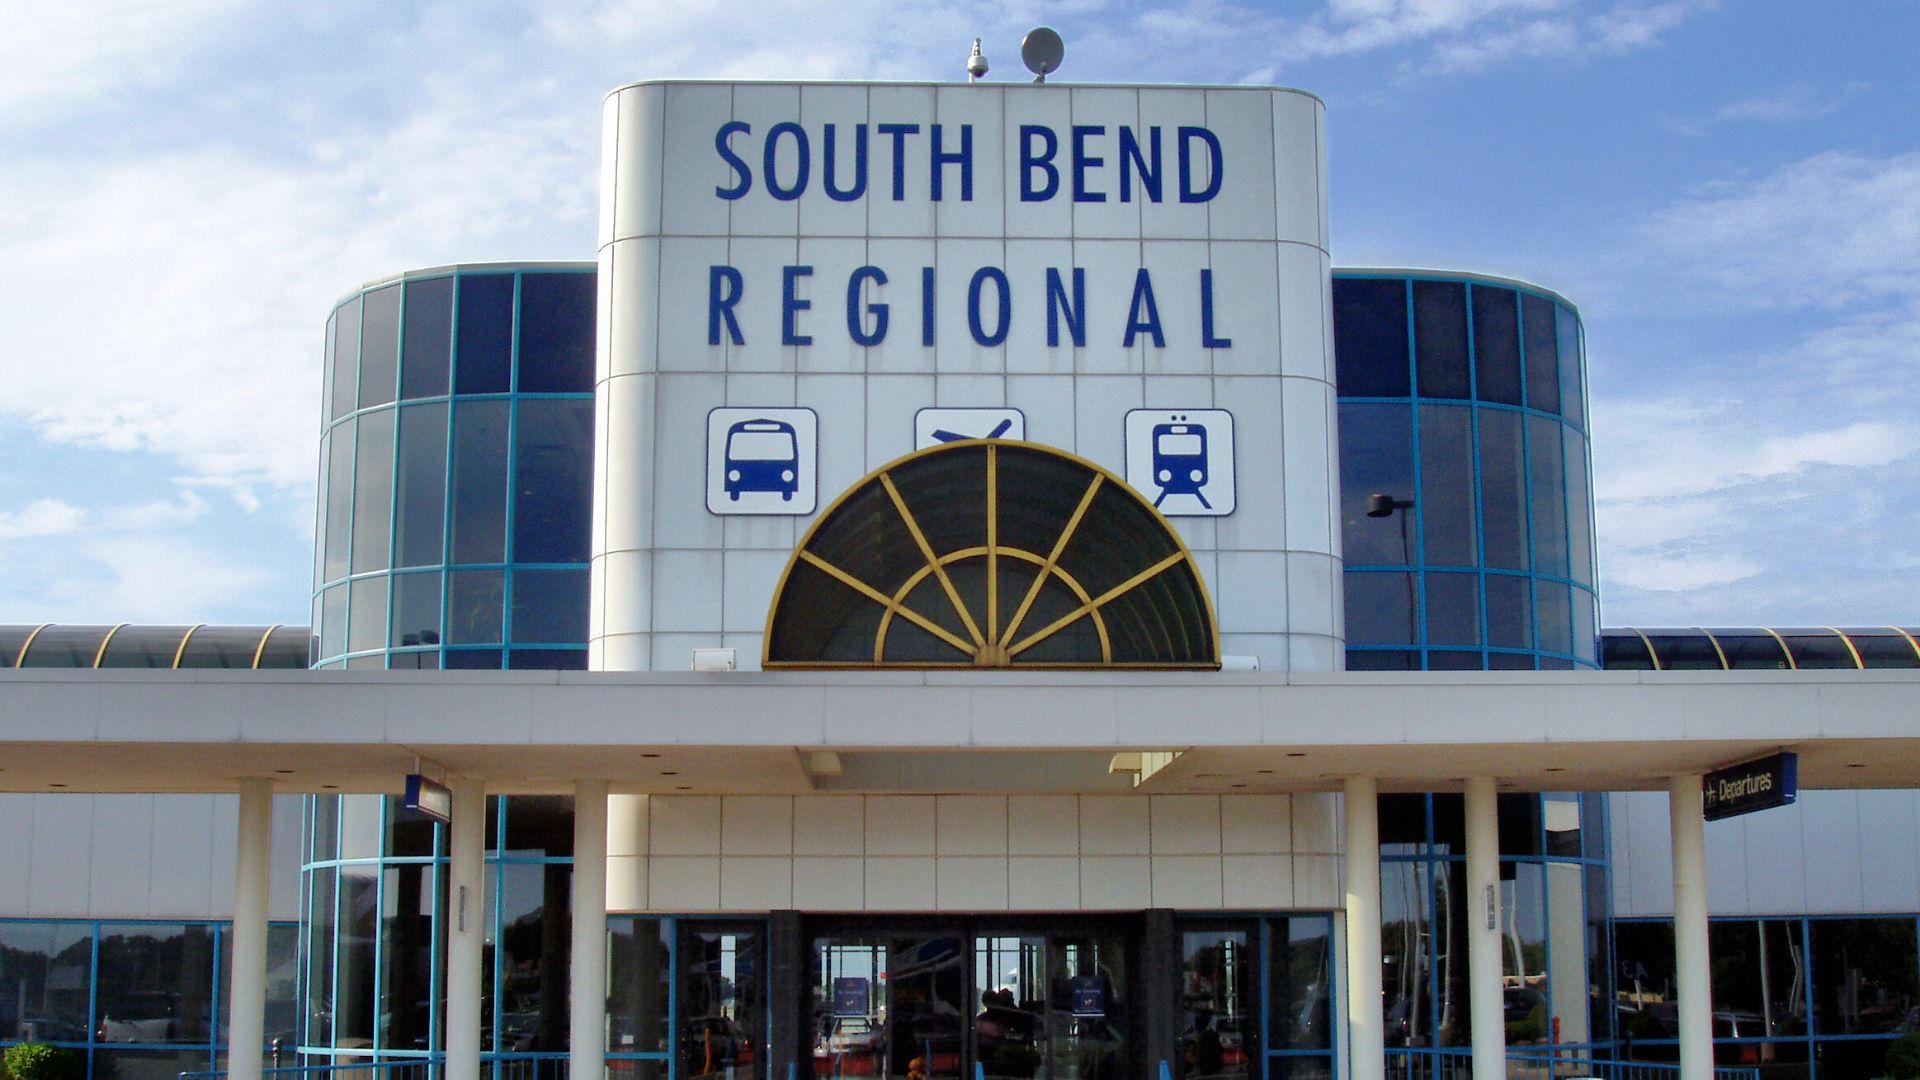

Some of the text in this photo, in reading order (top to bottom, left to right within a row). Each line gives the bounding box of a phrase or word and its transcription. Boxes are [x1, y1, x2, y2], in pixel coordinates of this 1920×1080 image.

[714, 121, 1224, 204] SOUTH BEND
[707, 265, 1232, 350] REGIONAL
[1719, 772, 1772, 803] Departures
